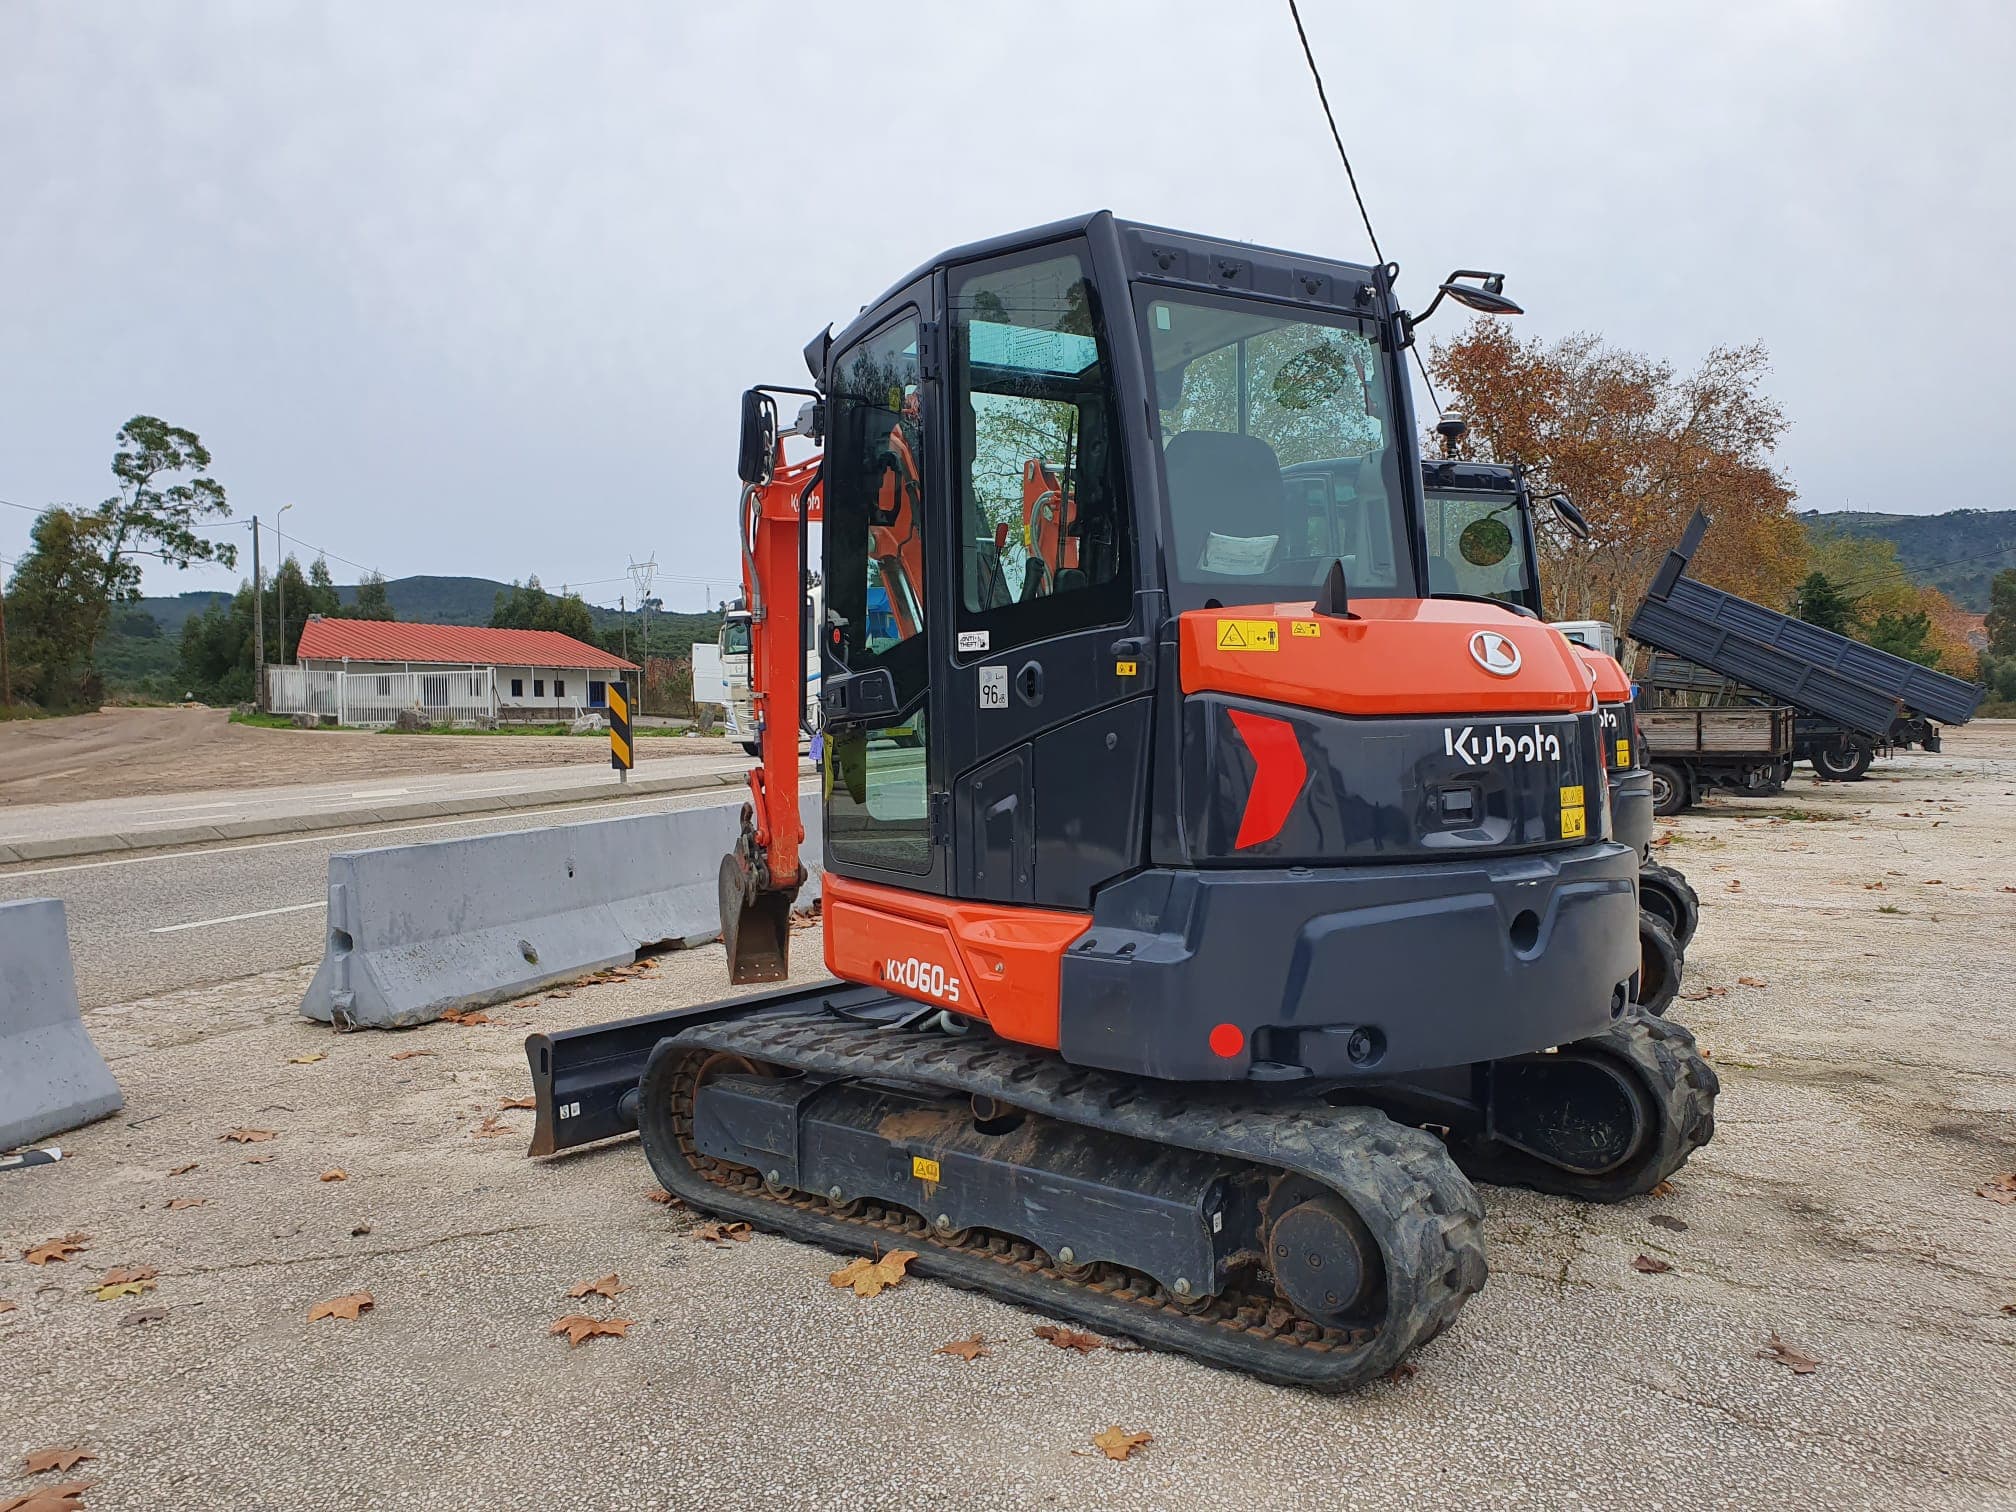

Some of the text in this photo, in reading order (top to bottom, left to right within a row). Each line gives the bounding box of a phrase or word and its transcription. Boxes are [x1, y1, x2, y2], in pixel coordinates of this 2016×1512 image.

[982, 685, 998, 704] 96
[1444, 724, 1560, 765] Kubota
[887, 957, 960, 1002] KX060-5
